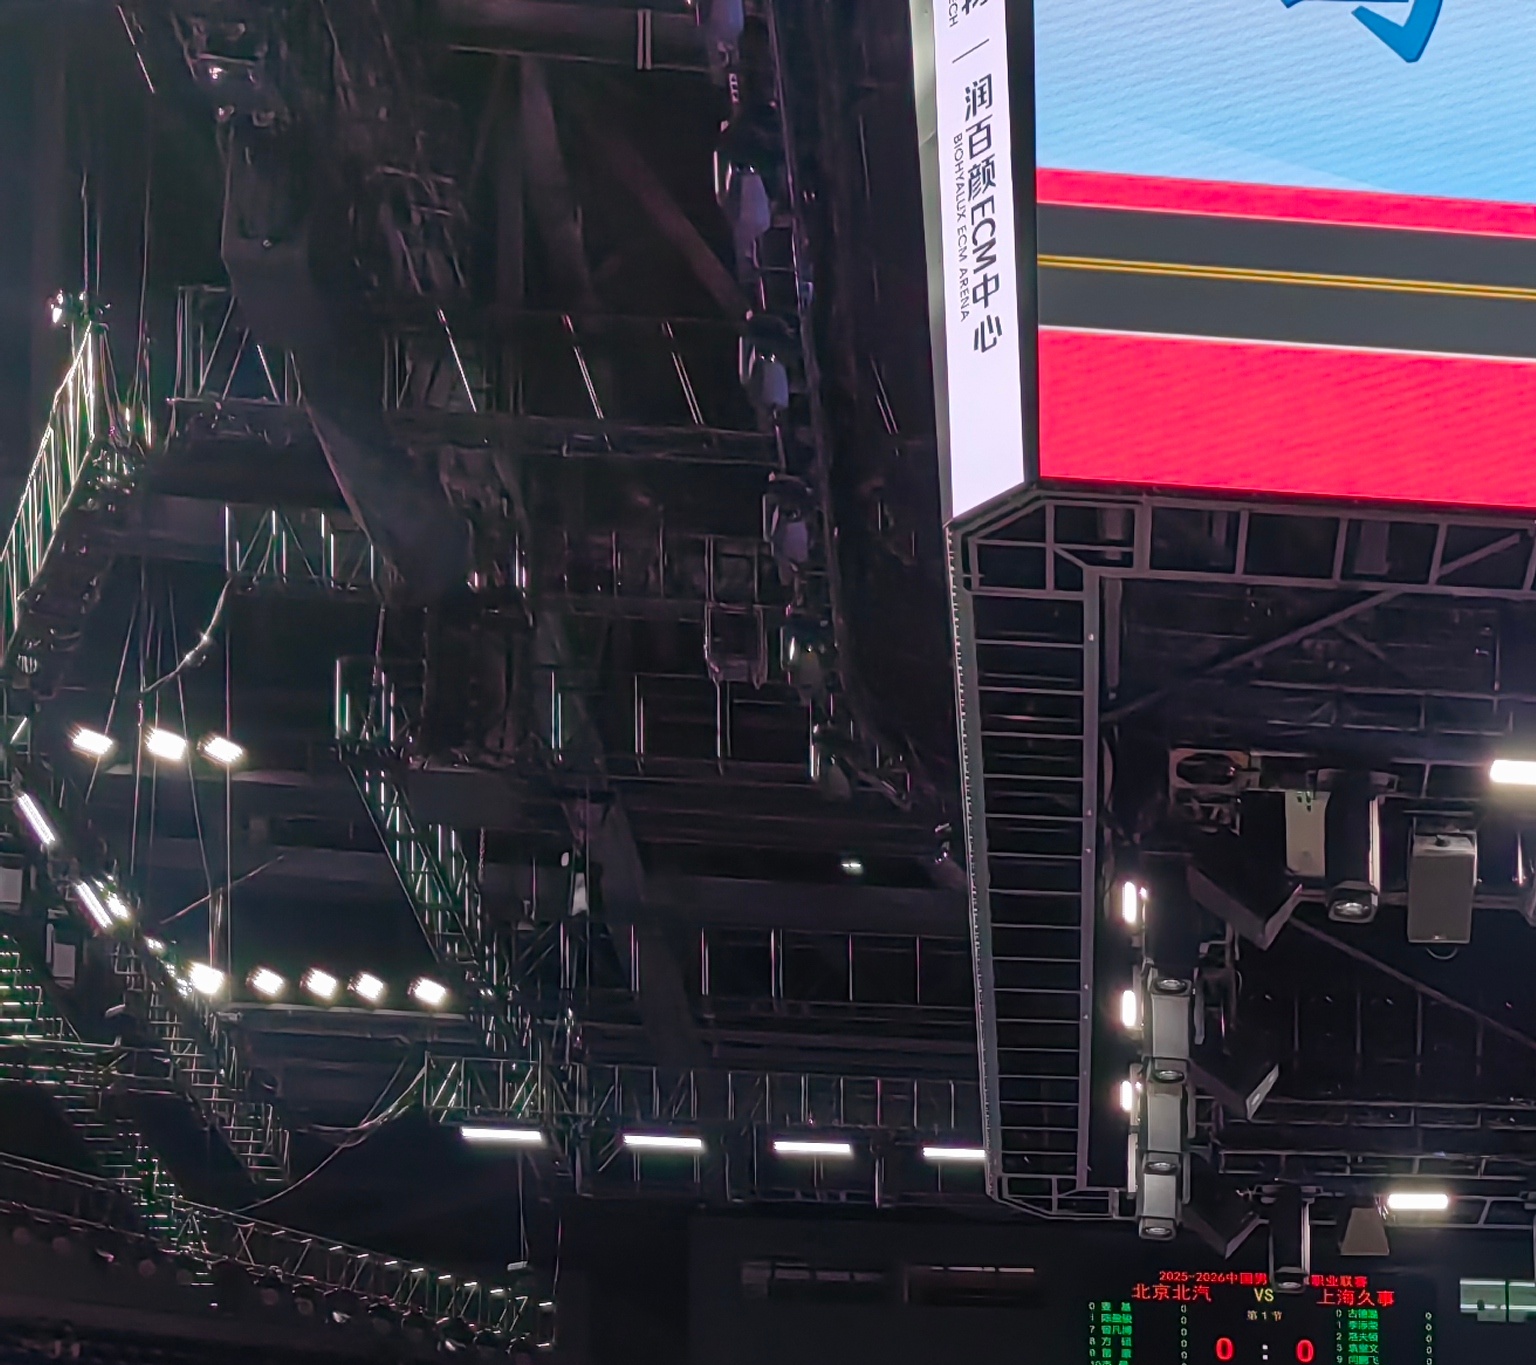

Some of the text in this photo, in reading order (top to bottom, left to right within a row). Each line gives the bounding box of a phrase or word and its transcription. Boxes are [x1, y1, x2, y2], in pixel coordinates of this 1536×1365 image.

[964, 73, 1003, 354] 润百颜ECM中心
[952, 132, 970, 322] BIOHYALUX ECM ARENA
[1131, 1285, 1213, 1301] 北京北汽
[1254, 1288, 1275, 1302] VS
[1316, 1289, 1395, 1307] 上海久事
[1216, 1337, 1234, 1360] 0
[1296, 1339, 1314, 1363] 0
